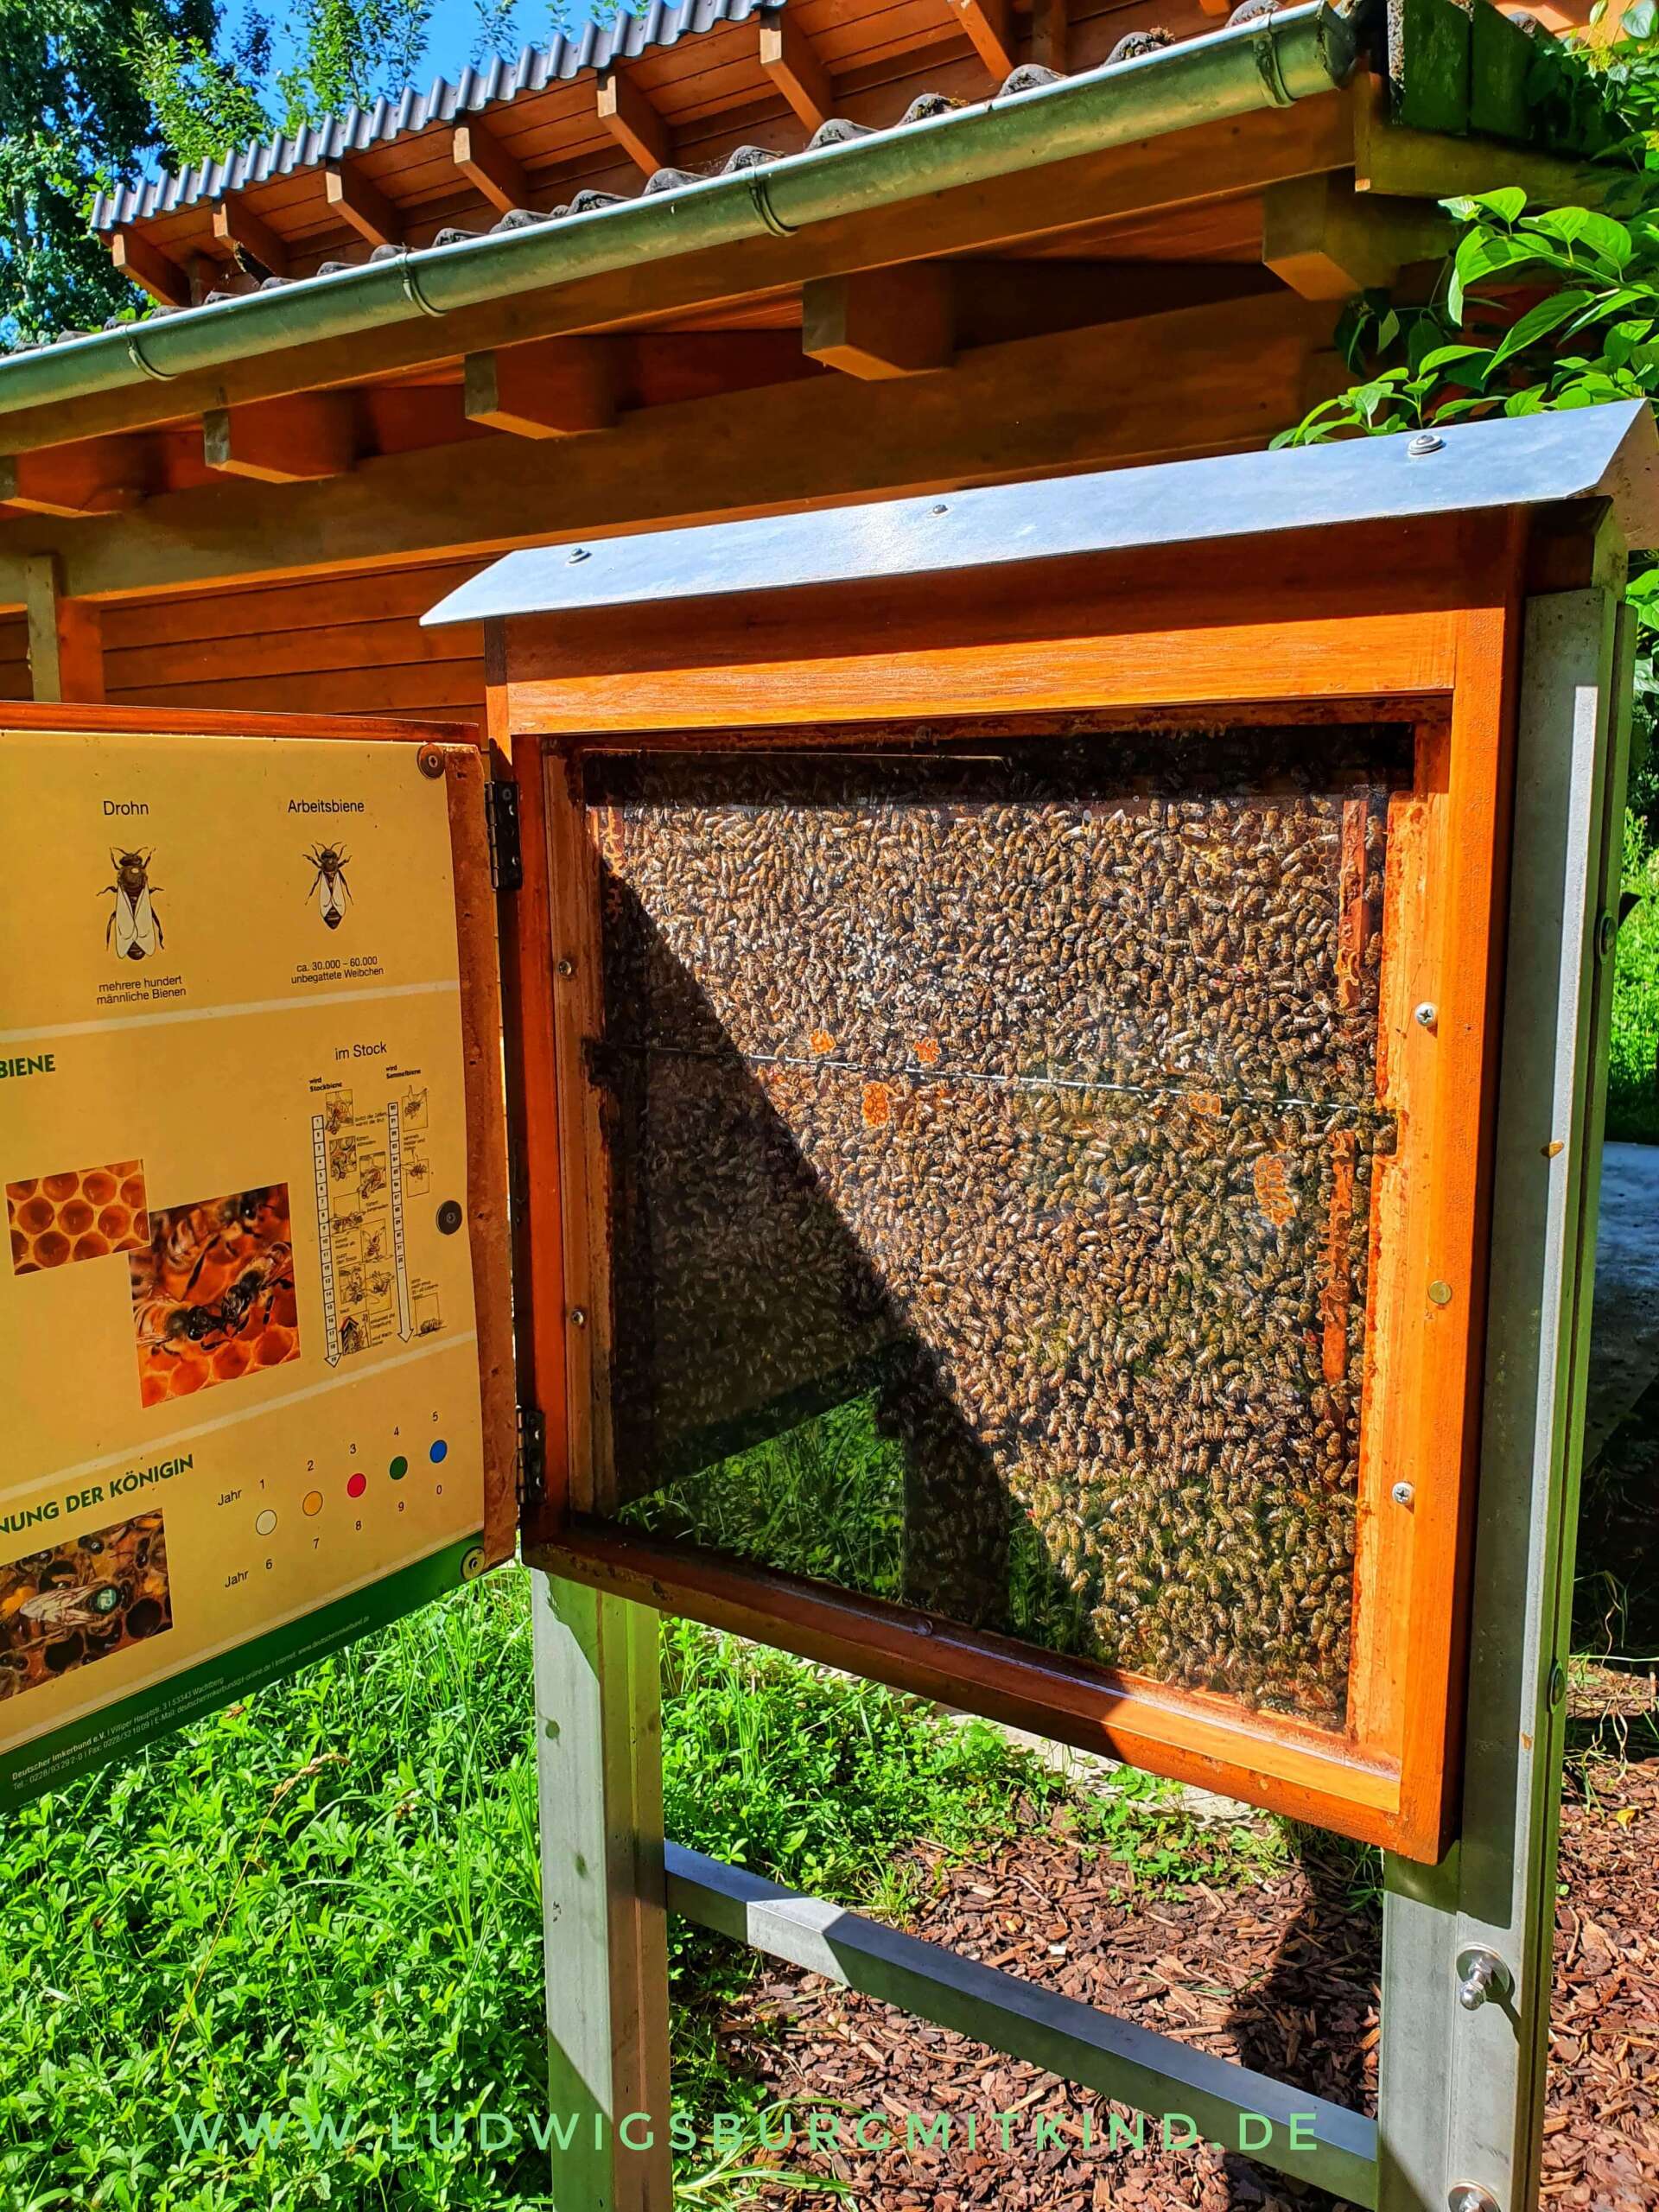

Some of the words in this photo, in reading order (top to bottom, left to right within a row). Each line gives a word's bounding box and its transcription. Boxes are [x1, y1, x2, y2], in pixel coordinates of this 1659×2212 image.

[103, 800, 149, 816] Drohn
[288, 798, 365, 813] Arbeitsbiene
[296, 963, 309, 972] ca.
[312, 959, 340, 971] 30.000
[350, 956, 378, 967] 60.000
[99, 981, 141, 993] mehrere
[143, 975, 182, 988] hundert
[291, 970, 342, 984] unbegattete
[344, 967, 384, 978] Weibchen
[97, 990, 149, 1005] männliche
[152, 988, 187, 999] Bienen
[334, 1047, 349, 1060] im
[353, 1041, 387, 1058] Stock
[0, 1053, 56, 1078] BIENE
[217, 1488, 243, 1507] Jahr
[259, 1478, 265, 1490] 1
[307, 1459, 315, 1471] 2
[349, 1443, 357, 1455] 3
[393, 1427, 399, 1437] 4
[432, 1411, 439, 1422] 5
[66, 1486, 104, 1513] DER
[110, 1454, 194, 1497] KÖNIGIN
[225, 1570, 249, 1588] Jahr
[265, 1559, 273, 1570] 6
[313, 1538, 320, 1549] 7
[355, 1520, 362, 1531] 8
[397, 1502, 405, 1512] 9
[435, 1484, 442, 1495] 0
[12, 1757, 51, 1781] Deutscher
[52, 1738, 92, 1762] Imkerbund
[92, 1731, 105, 1744] e.V.
[192, 1676, 225, 1696] Wachtberg
